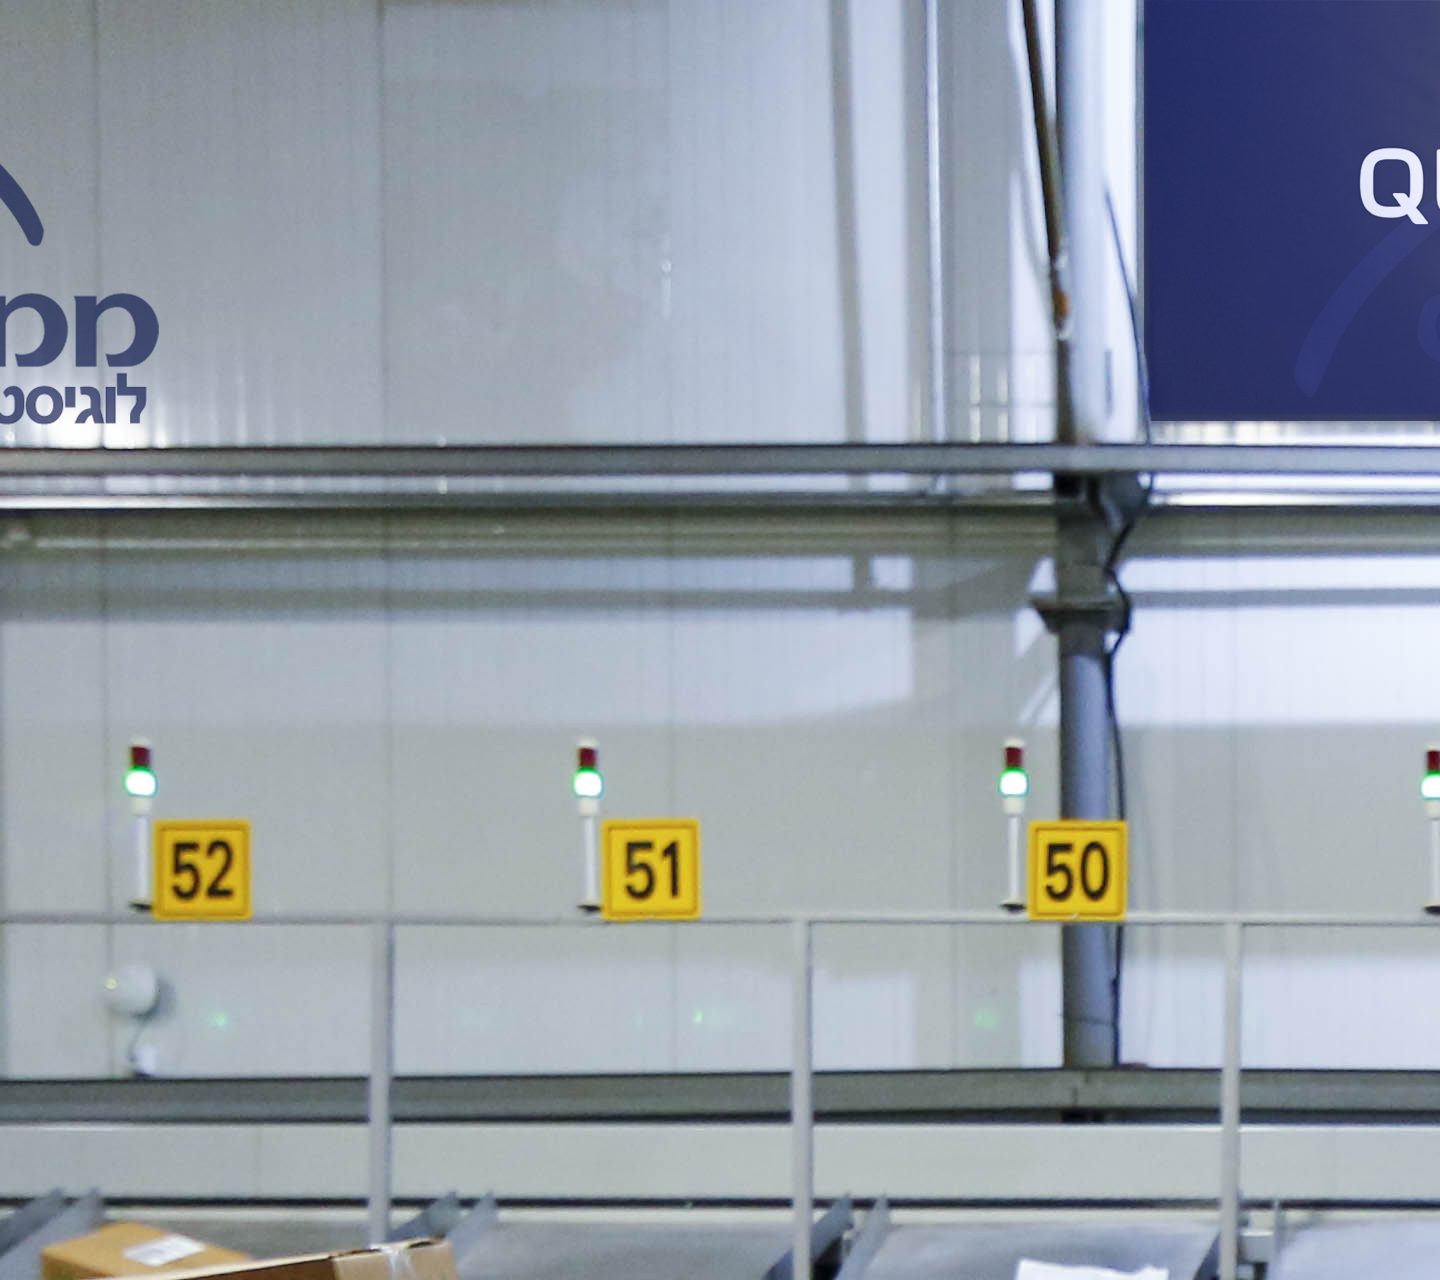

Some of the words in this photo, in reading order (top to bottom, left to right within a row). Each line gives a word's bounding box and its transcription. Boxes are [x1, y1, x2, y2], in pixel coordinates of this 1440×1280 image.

[172, 839, 234, 901] 52
[622, 840, 681, 901] 51
[1045, 841, 1110, 902] 50
